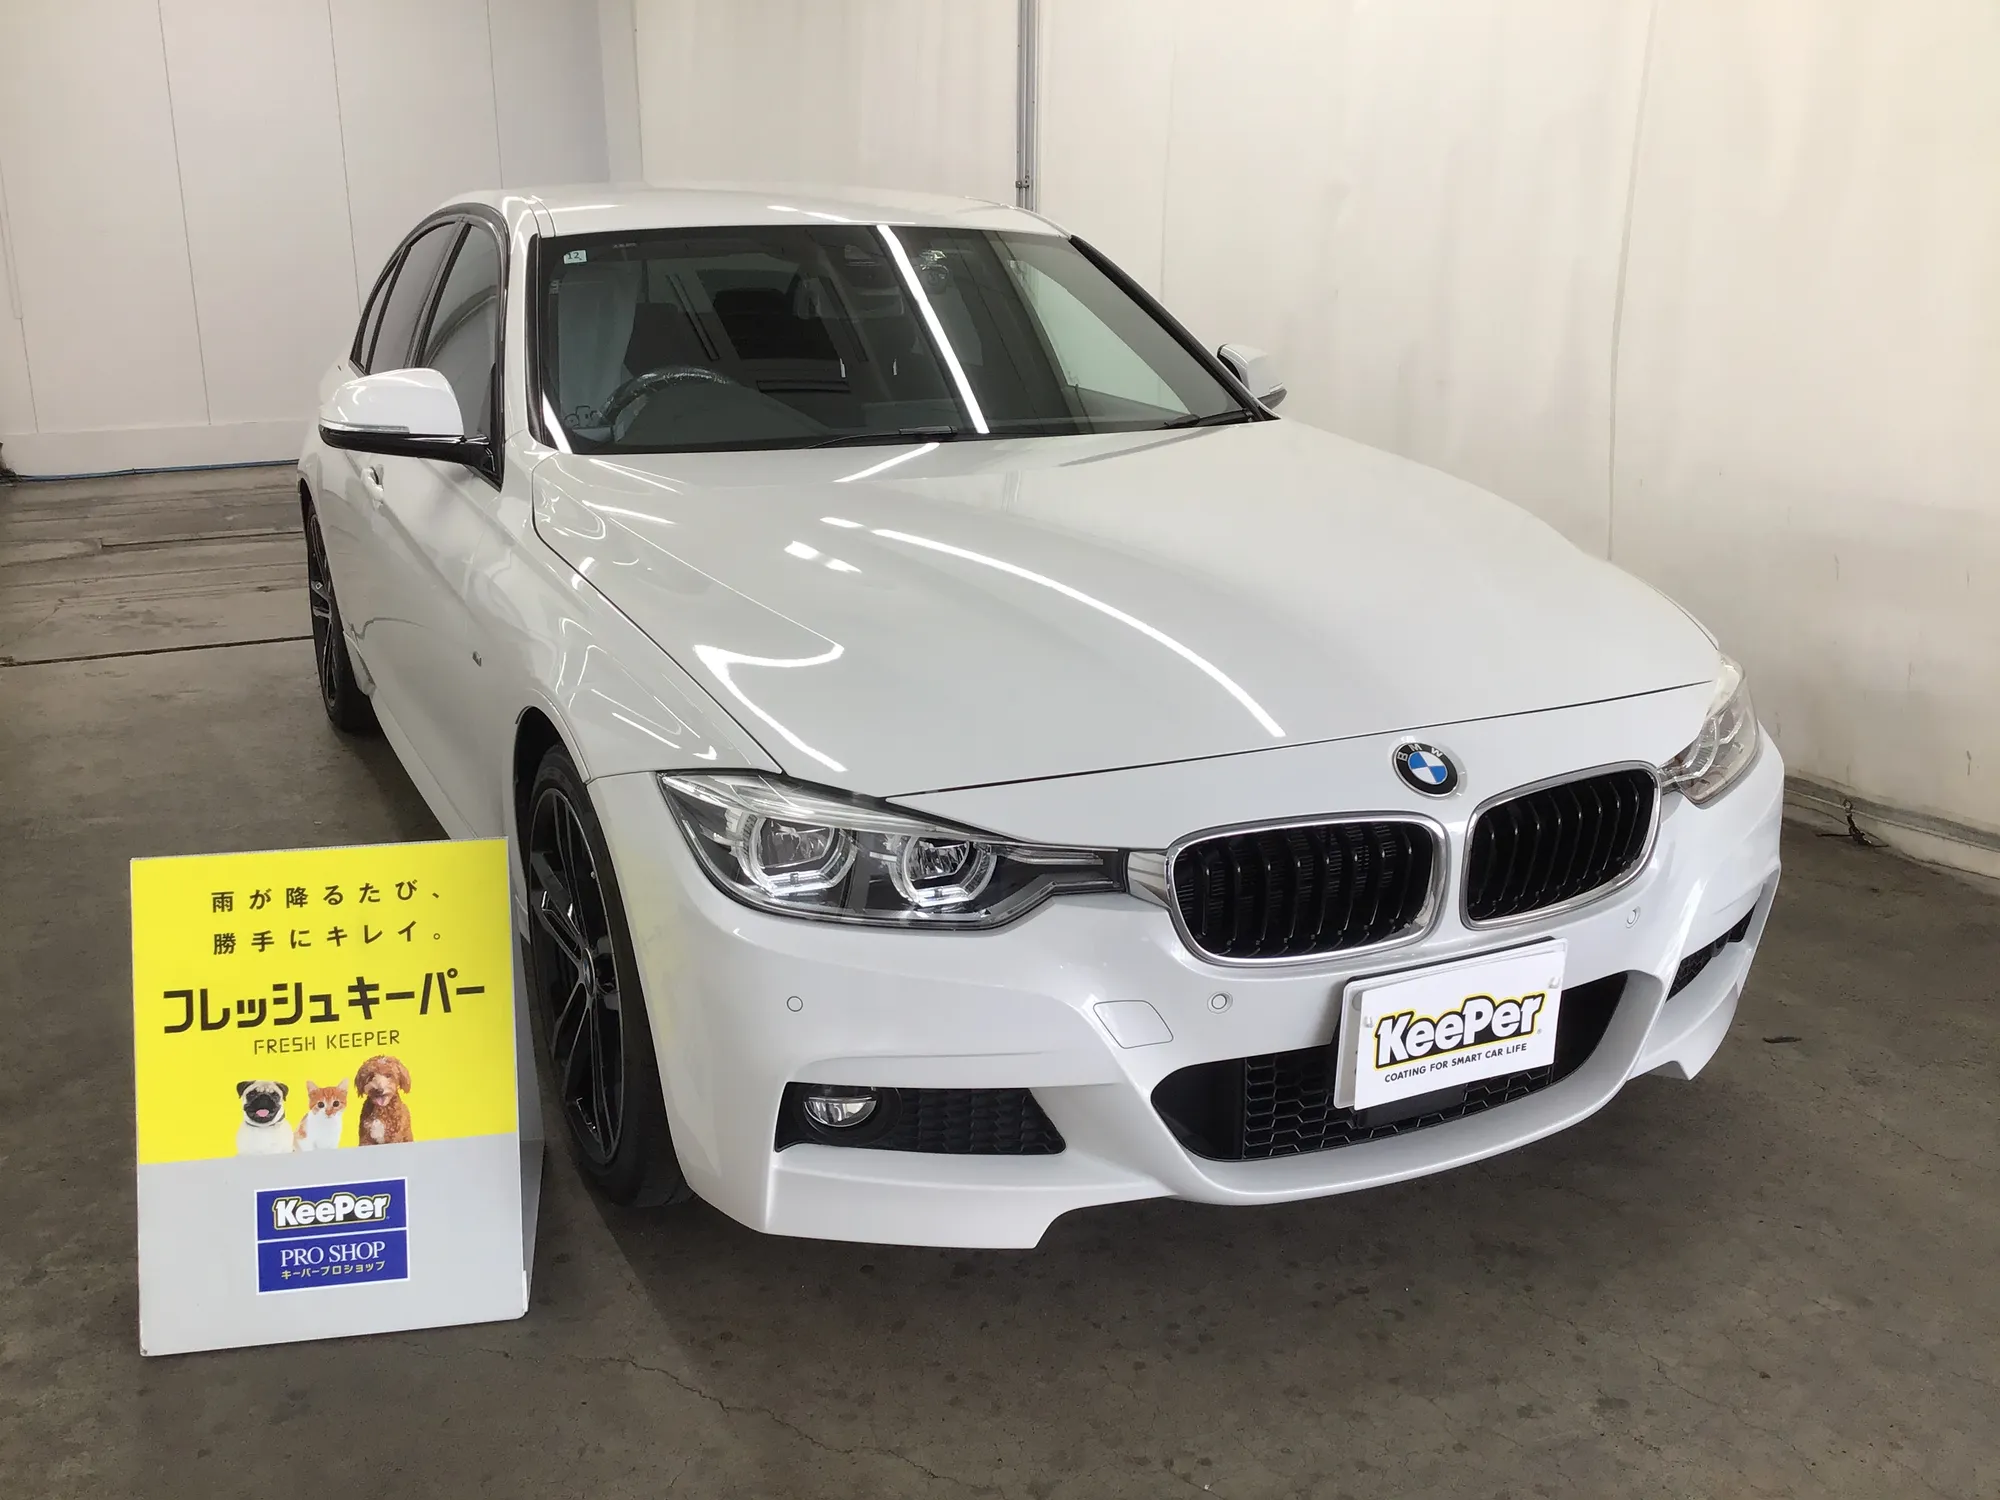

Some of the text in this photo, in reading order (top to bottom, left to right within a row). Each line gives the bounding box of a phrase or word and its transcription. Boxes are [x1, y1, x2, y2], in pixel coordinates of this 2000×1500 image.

[1397, 743, 1443, 762] BMW
[211, 879, 441, 914] 雨が降るたび、
[213, 920, 441, 956] 勝手にキレイ。
[163, 967, 485, 1034] フレッシュキーパー
[254, 1029, 400, 1055] FRESH KEEPER
[1375, 993, 1545, 1069] KeePer
[1384, 1043, 1528, 1083] COATING FOR SMART CAR LIFE
[273, 1193, 390, 1229] KeePer
[280, 1240, 386, 1268] PRO SHOP
